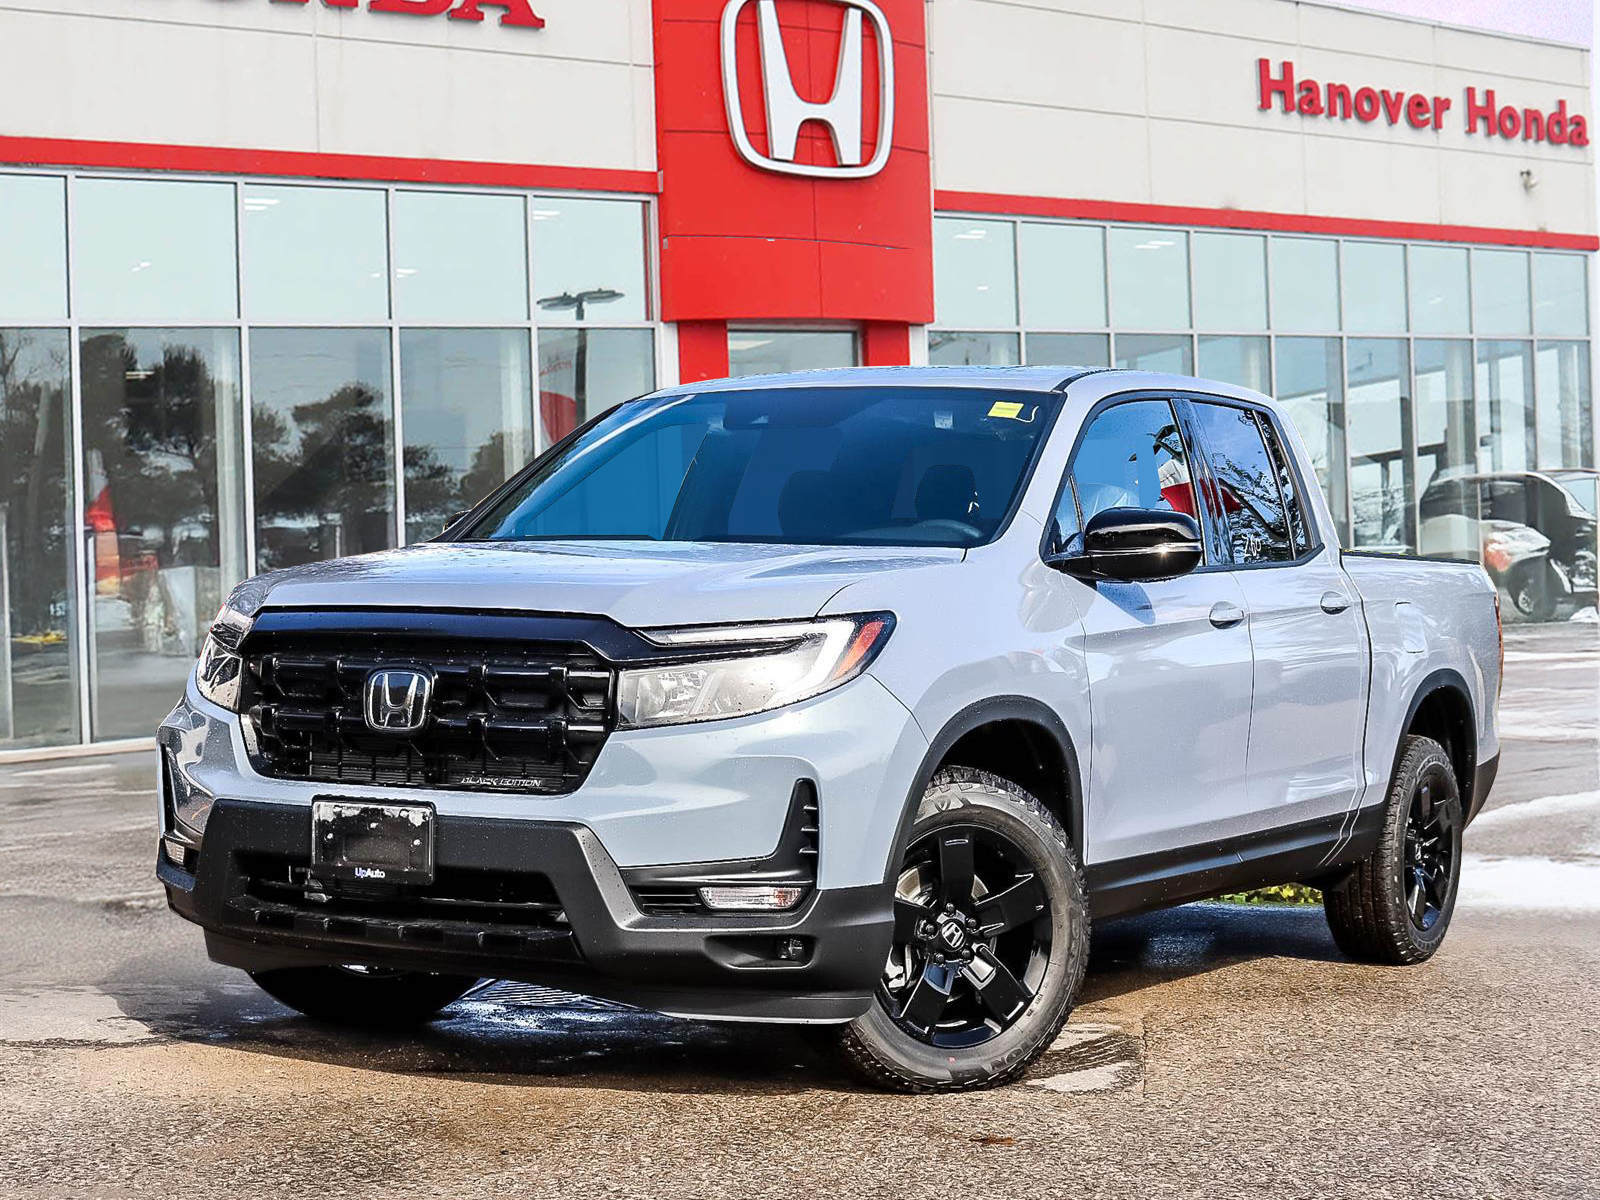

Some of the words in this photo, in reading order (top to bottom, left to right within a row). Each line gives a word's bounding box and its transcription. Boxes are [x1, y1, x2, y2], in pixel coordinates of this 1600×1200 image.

[1258, 57, 1453, 130] Hanover
[1465, 86, 1590, 147] Honda
[460, 776, 499, 786] BLACK
[499, 778, 542, 787] EDITION
[354, 867, 386, 879] UpAuto
